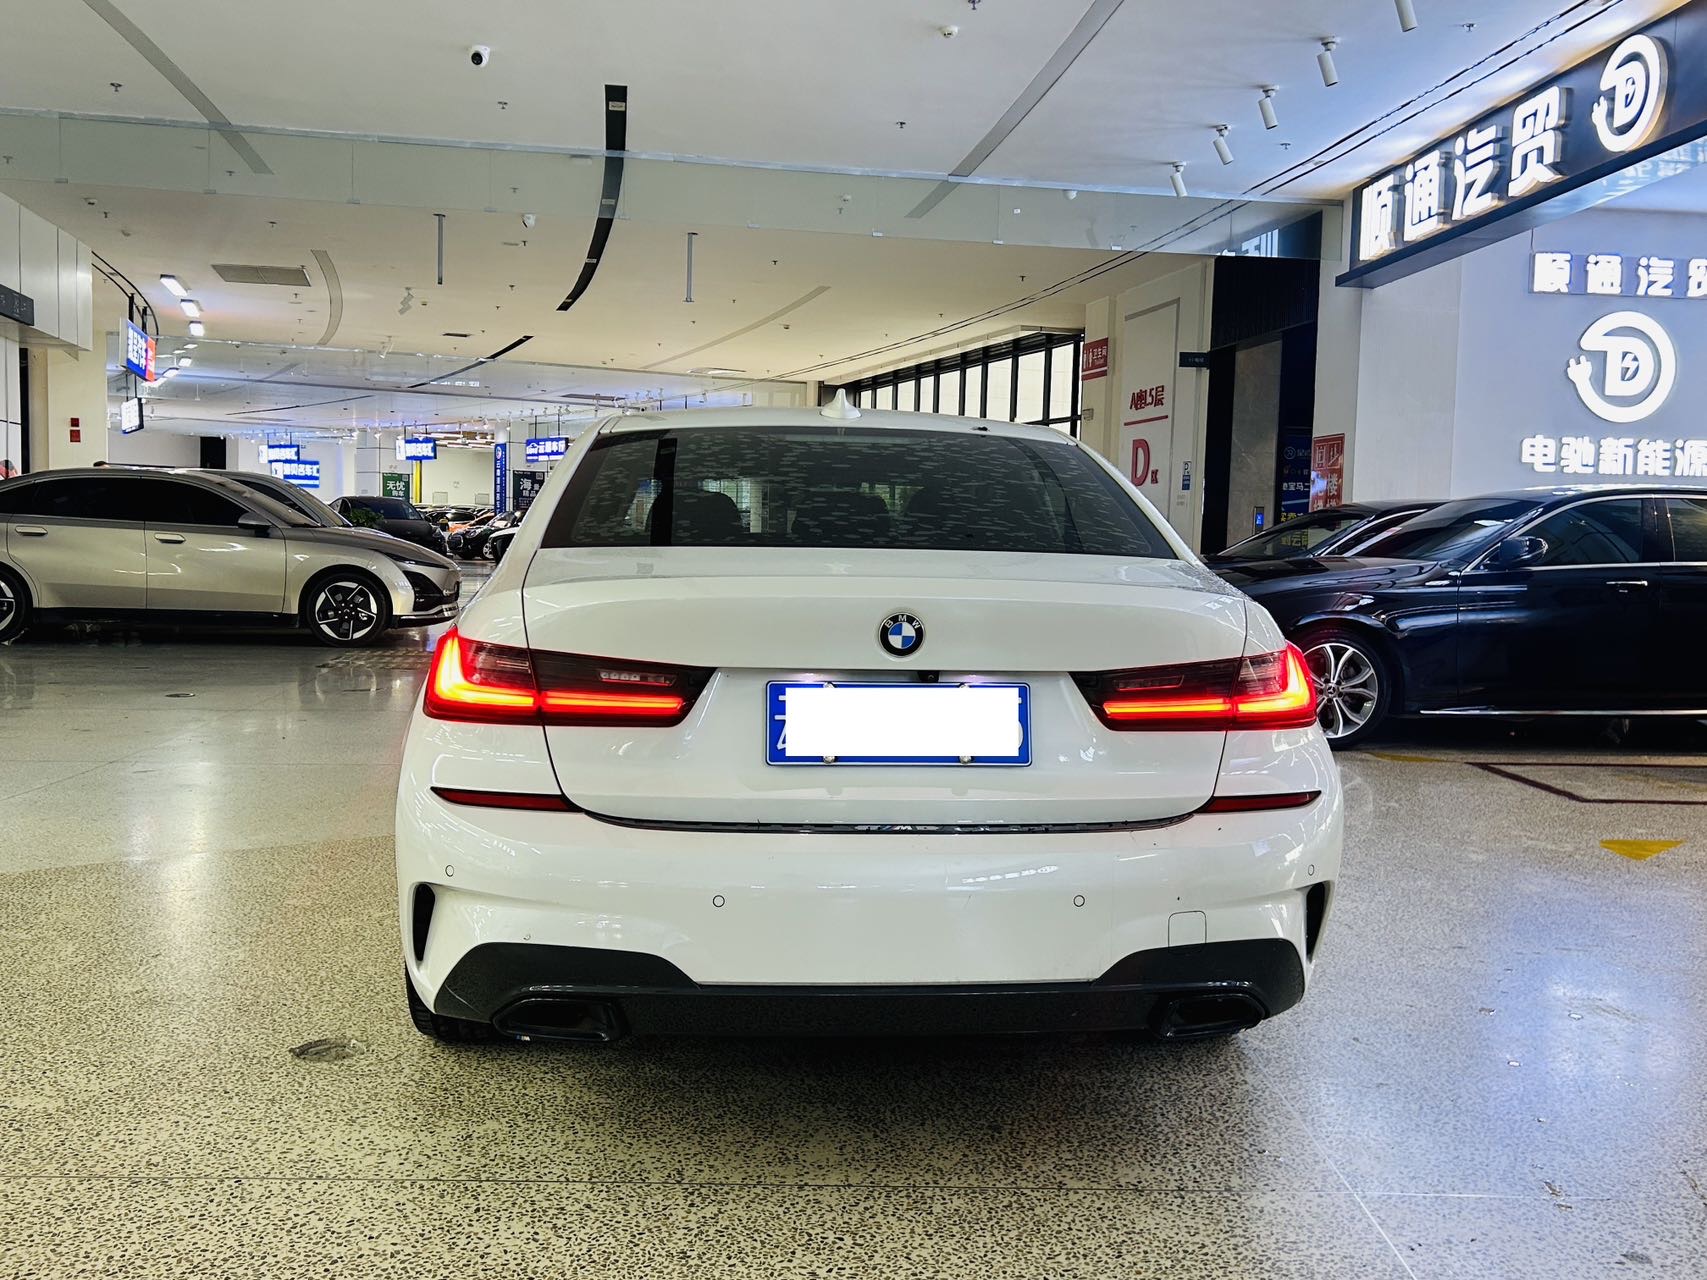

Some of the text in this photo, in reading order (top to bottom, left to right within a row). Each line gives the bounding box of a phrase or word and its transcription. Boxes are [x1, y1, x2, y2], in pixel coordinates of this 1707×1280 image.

[1359, 86, 1565, 261] 顺通汽贸
[1521, 434, 1707, 477] 电驰新能源
[386, 480, 406, 491] 无忧
[884, 614, 921, 629] BMW
